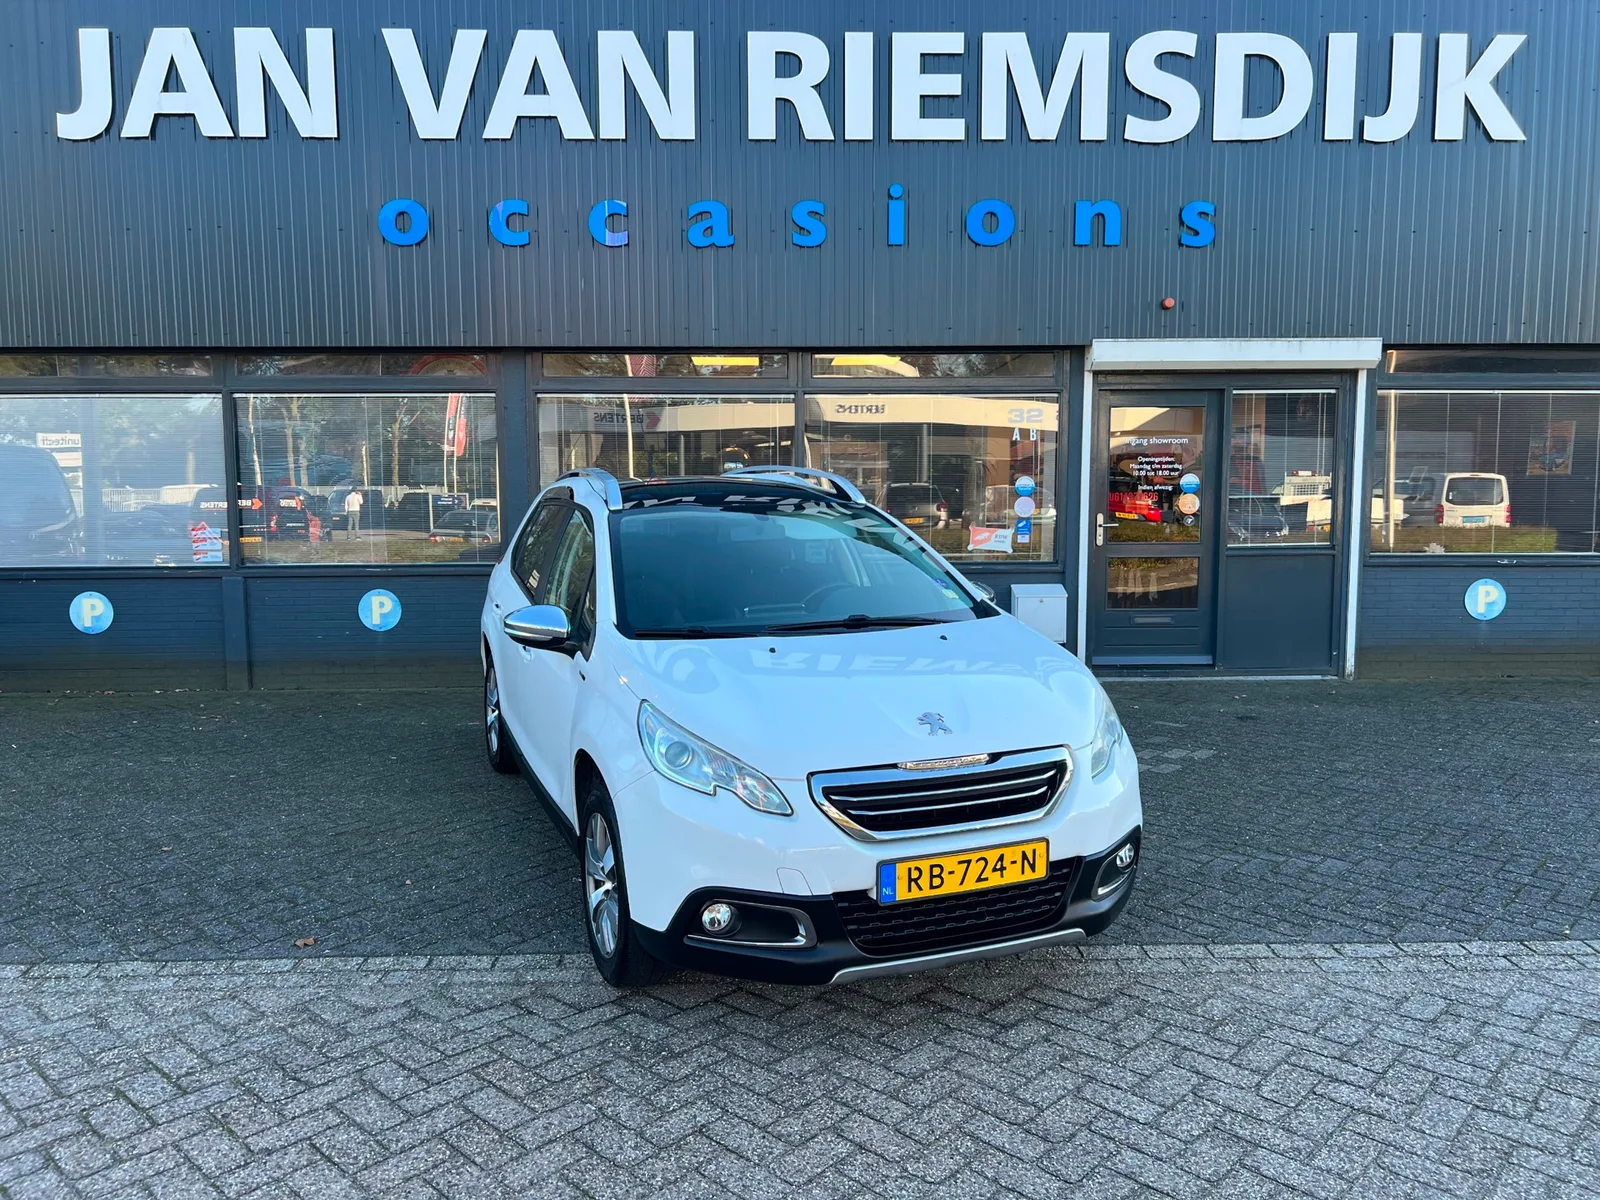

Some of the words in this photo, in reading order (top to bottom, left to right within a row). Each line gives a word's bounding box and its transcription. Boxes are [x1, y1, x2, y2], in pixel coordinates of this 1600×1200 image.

[56, 27, 338, 141] JAN
[381, 28, 696, 141] VAN
[747, 30, 1528, 143] RIEMSDIJK
[378, 183, 1218, 248] occasions
[1008, 408, 1044, 424] 32
[1012, 427, 1021, 441] A
[1029, 427, 1037, 441] B
[1149, 436, 1189, 444] showroom
[81, 597, 105, 628] P
[371, 595, 393, 625] P
[1477, 585, 1499, 614] P
[882, 887, 895, 896] NL
[907, 848, 1037, 894] RB-724-N
